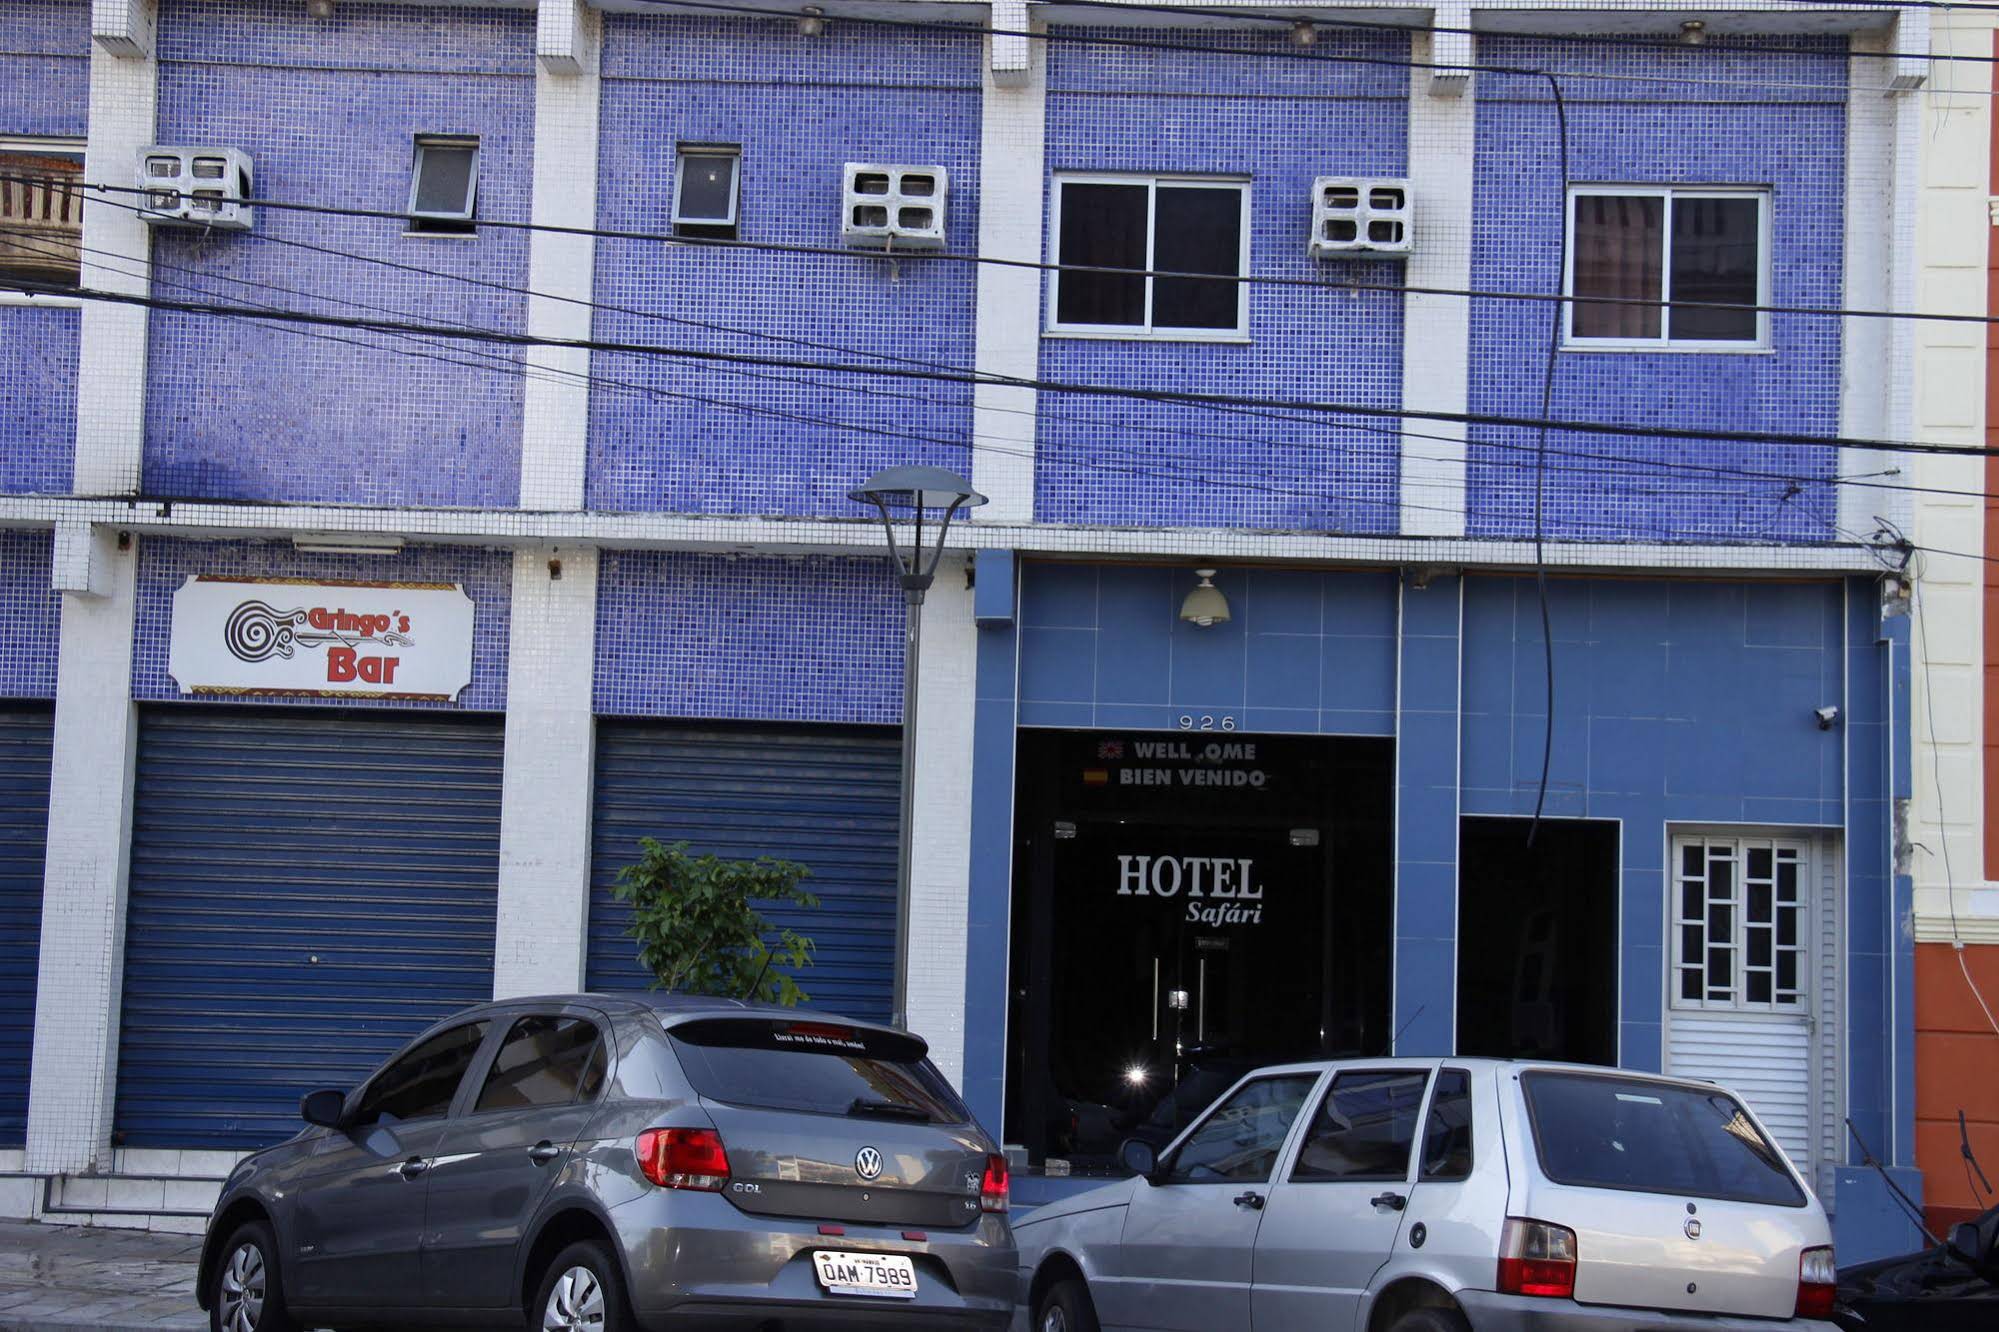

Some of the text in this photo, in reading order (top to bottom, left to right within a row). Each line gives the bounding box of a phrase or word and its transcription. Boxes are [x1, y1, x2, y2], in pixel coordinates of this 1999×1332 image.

[327, 647, 400, 684] Bar
[1179, 715, 1235, 730] 926
[1120, 768, 1265, 787] BIEN VENIDO
[1117, 855, 1263, 898] HOTEL
